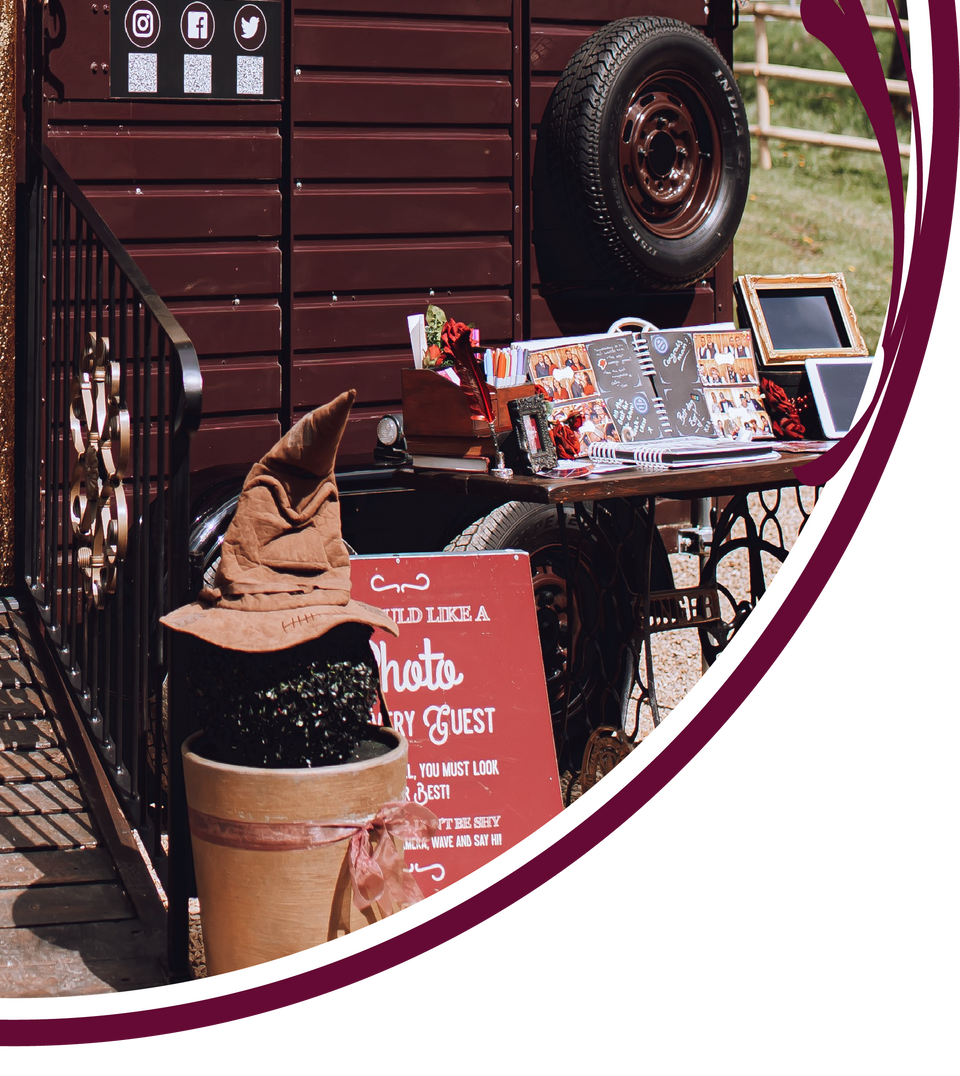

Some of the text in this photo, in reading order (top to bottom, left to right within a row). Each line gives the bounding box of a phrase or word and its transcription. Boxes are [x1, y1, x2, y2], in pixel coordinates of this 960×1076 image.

[383, 605, 491, 624] ULD LIKE A
[368, 637, 464, 693] hoto
[423, 704, 496, 746] GUEST
[419, 762, 440, 778] YOU
[442, 760, 470, 777] MUST
[472, 759, 500, 776] LOOK
[413, 782, 451, 806] BEST!
[454, 815, 472, 830] BE
[473, 814, 502, 829] SHY
[431, 835, 454, 849] WAVE
[456, 835, 472, 848] AND
[473, 833, 489, 847] SAY
[491, 833, 502, 846] HI!
